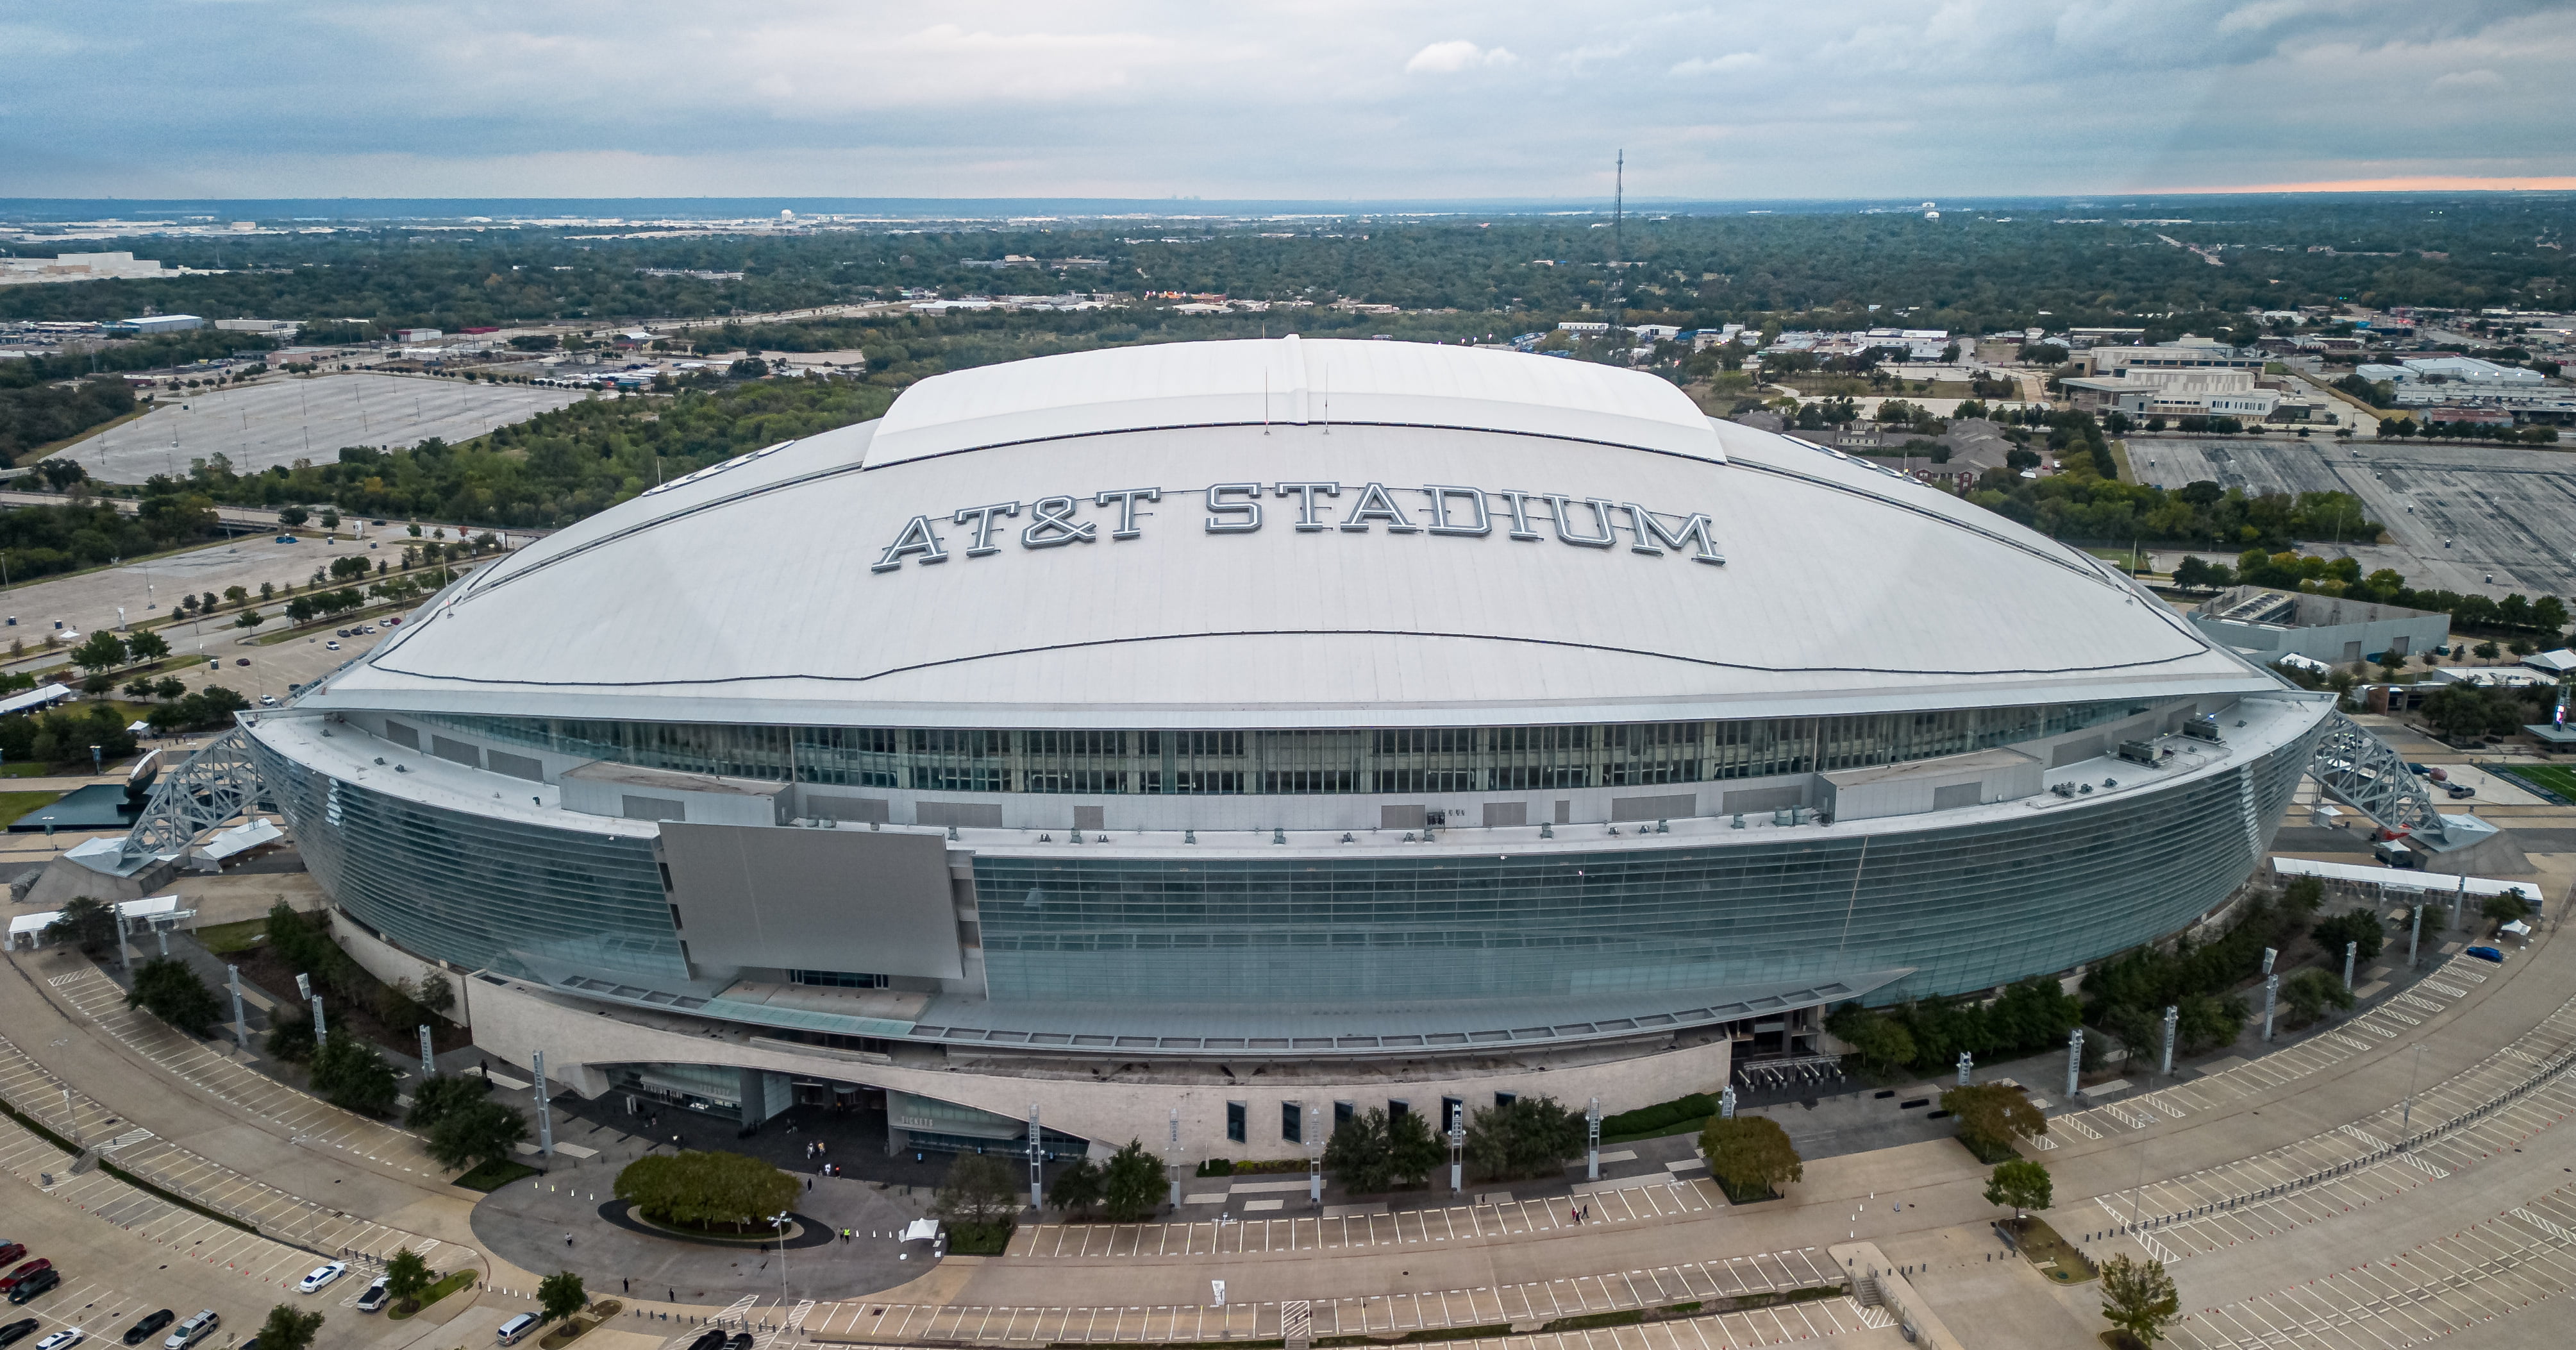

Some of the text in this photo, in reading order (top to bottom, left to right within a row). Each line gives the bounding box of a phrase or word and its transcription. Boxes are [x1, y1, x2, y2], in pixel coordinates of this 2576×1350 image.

[871, 481, 1726, 573] AT&T STADIUM
[901, 1116, 933, 1127] TICKETS
